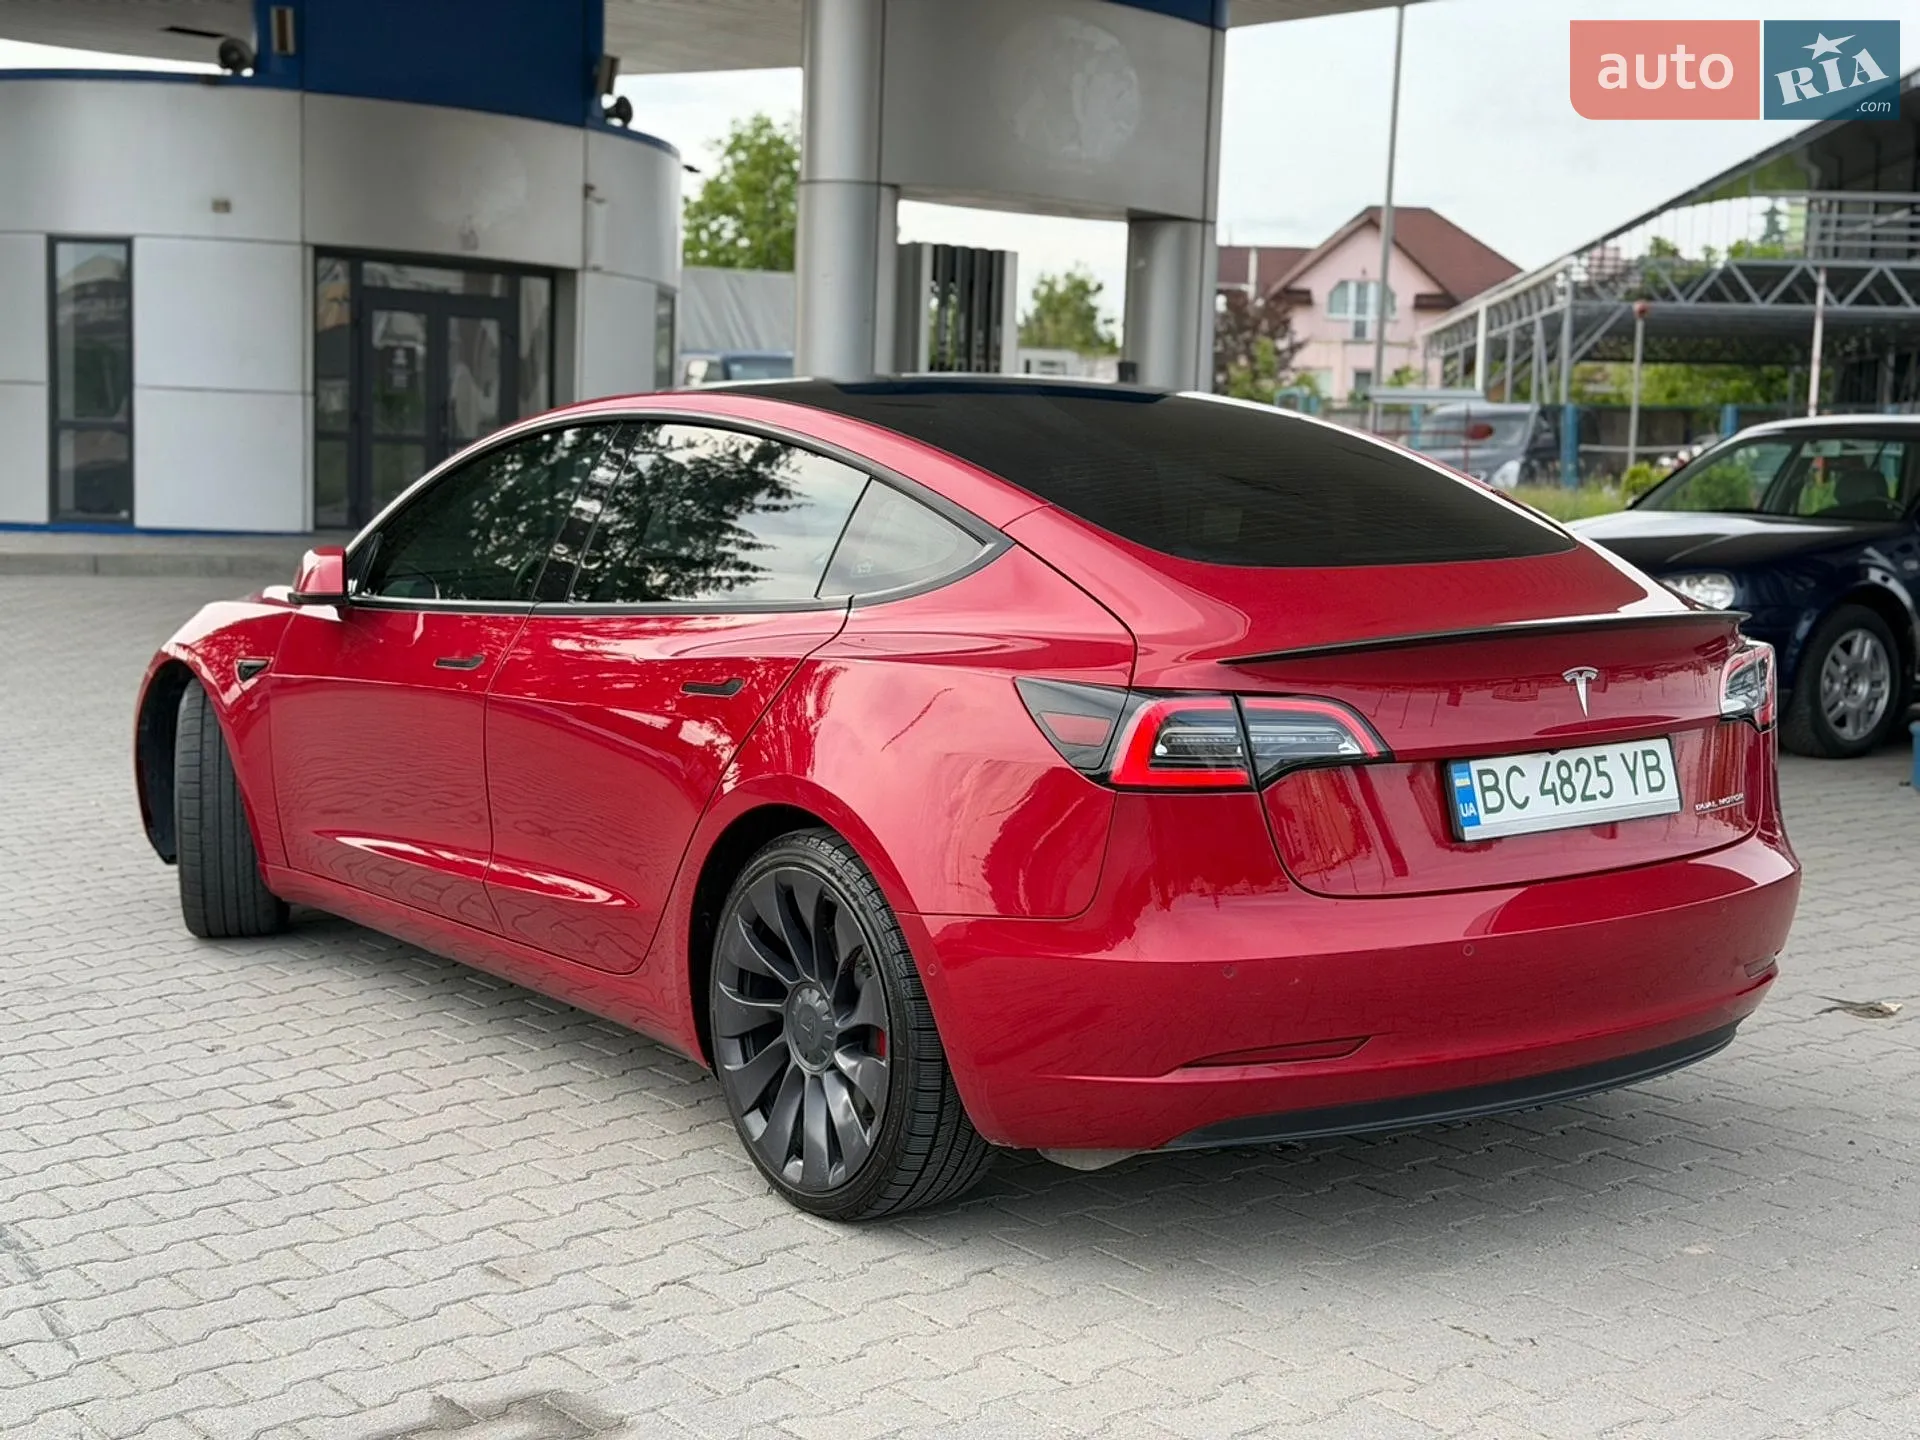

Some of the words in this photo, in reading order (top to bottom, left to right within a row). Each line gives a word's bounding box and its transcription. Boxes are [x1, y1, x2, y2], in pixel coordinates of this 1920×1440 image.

[1476, 764, 1531, 815] BC
[1539, 754, 1614, 806] 4825
[1620, 749, 1667, 796] YB
[1460, 802, 1477, 817] UA
[1695, 800, 1718, 811] DUAL
[1718, 792, 1744, 805] MOTOR
